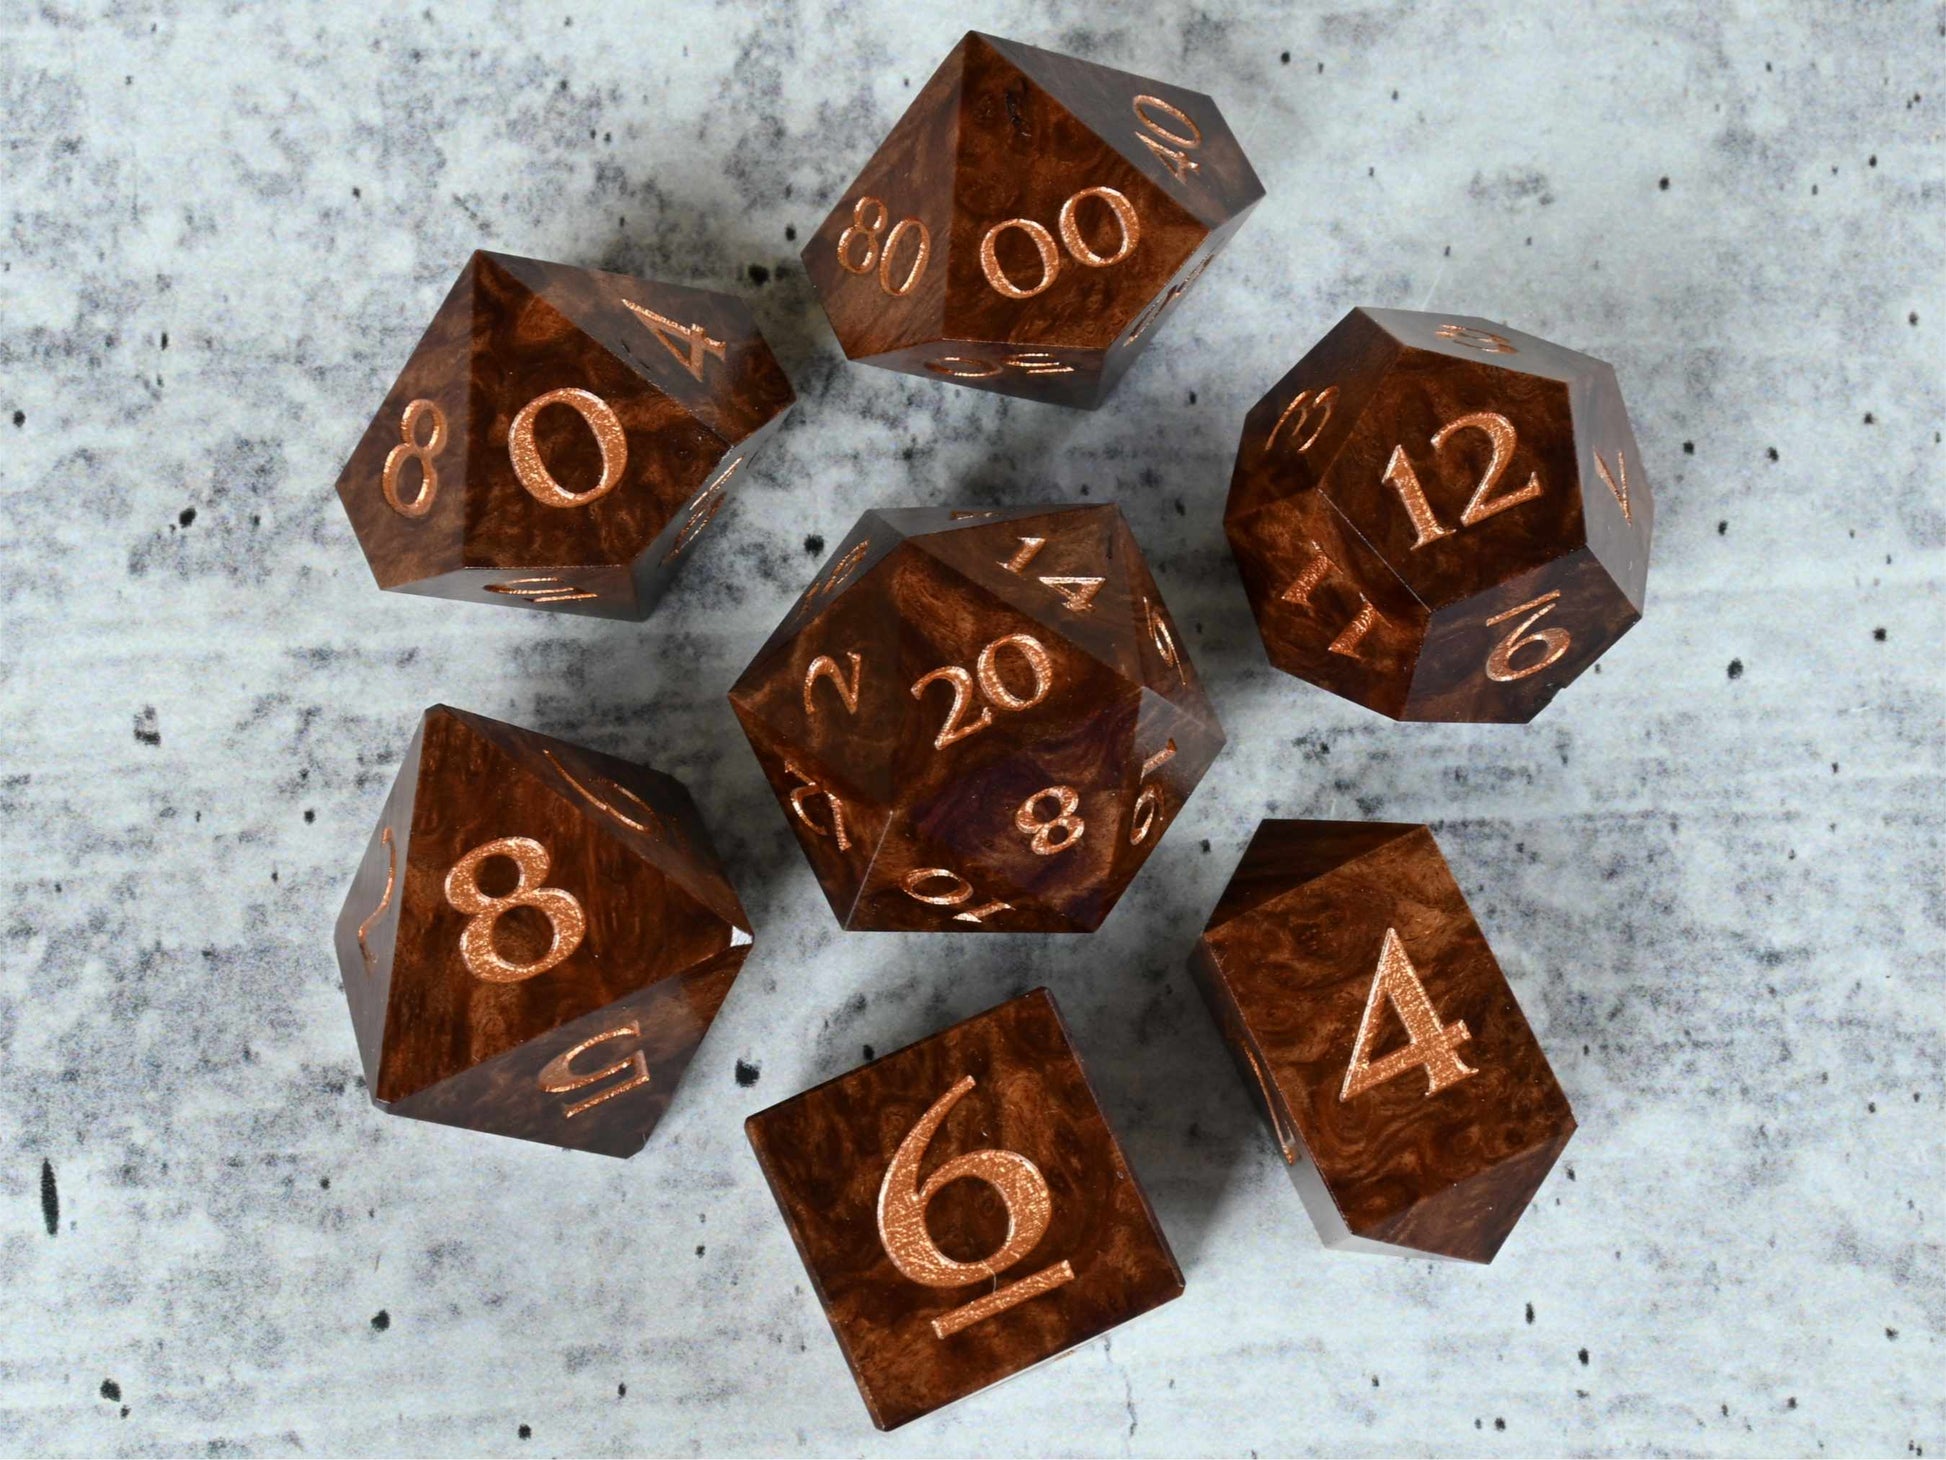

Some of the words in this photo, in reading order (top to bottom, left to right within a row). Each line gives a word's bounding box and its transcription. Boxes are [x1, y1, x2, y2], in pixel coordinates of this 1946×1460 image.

[837, 196, 931, 296] 80
[979, 186, 1140, 299] 00
[622, 298, 728, 382] 4
[382, 398, 448, 518] 8
[508, 387, 628, 509] 0
[1264, 385, 1340, 453] 3
[1381, 411, 1544, 551] 12
[996, 536, 1105, 613] 14
[803, 649, 862, 715] 2
[910, 632, 1054, 750] 20
[1015, 784, 1086, 856] 8
[443, 835, 587, 984] 8
[1338, 926, 1480, 1104] 4
[877, 1074, 1077, 1342] 6
